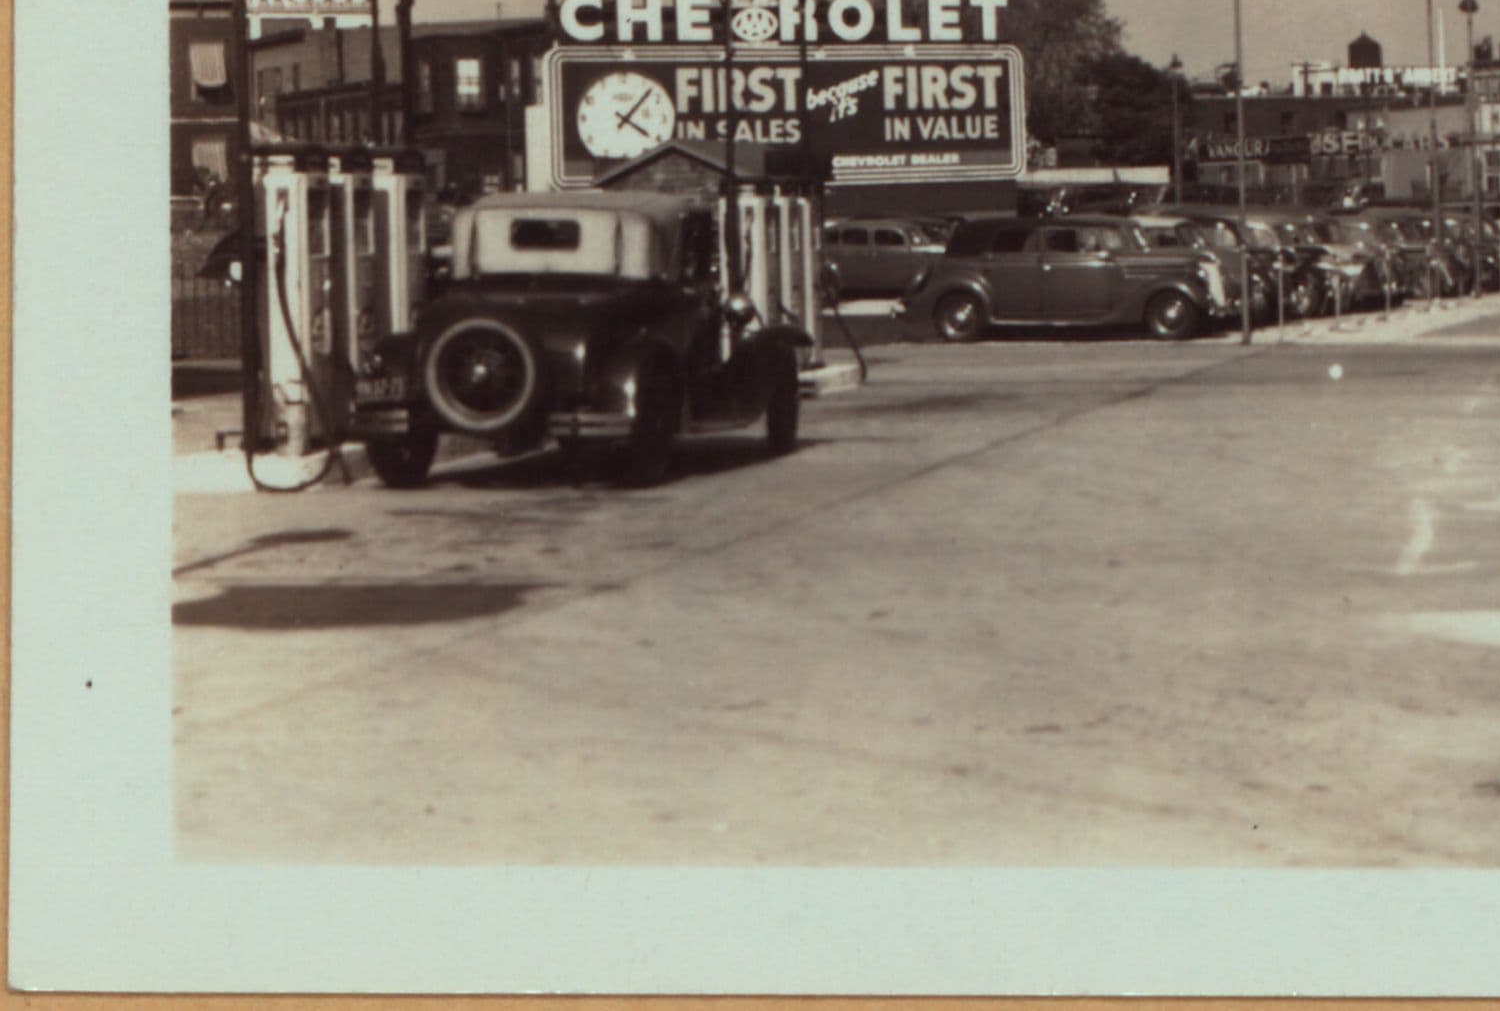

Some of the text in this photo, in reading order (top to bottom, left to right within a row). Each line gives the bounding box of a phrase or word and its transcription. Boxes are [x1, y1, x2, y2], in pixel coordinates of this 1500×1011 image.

[675, 67, 802, 113] FIRST
[882, 65, 1003, 111] FIRST
[676, 120, 706, 140] IN
[884, 115, 999, 141] IN VALUE
